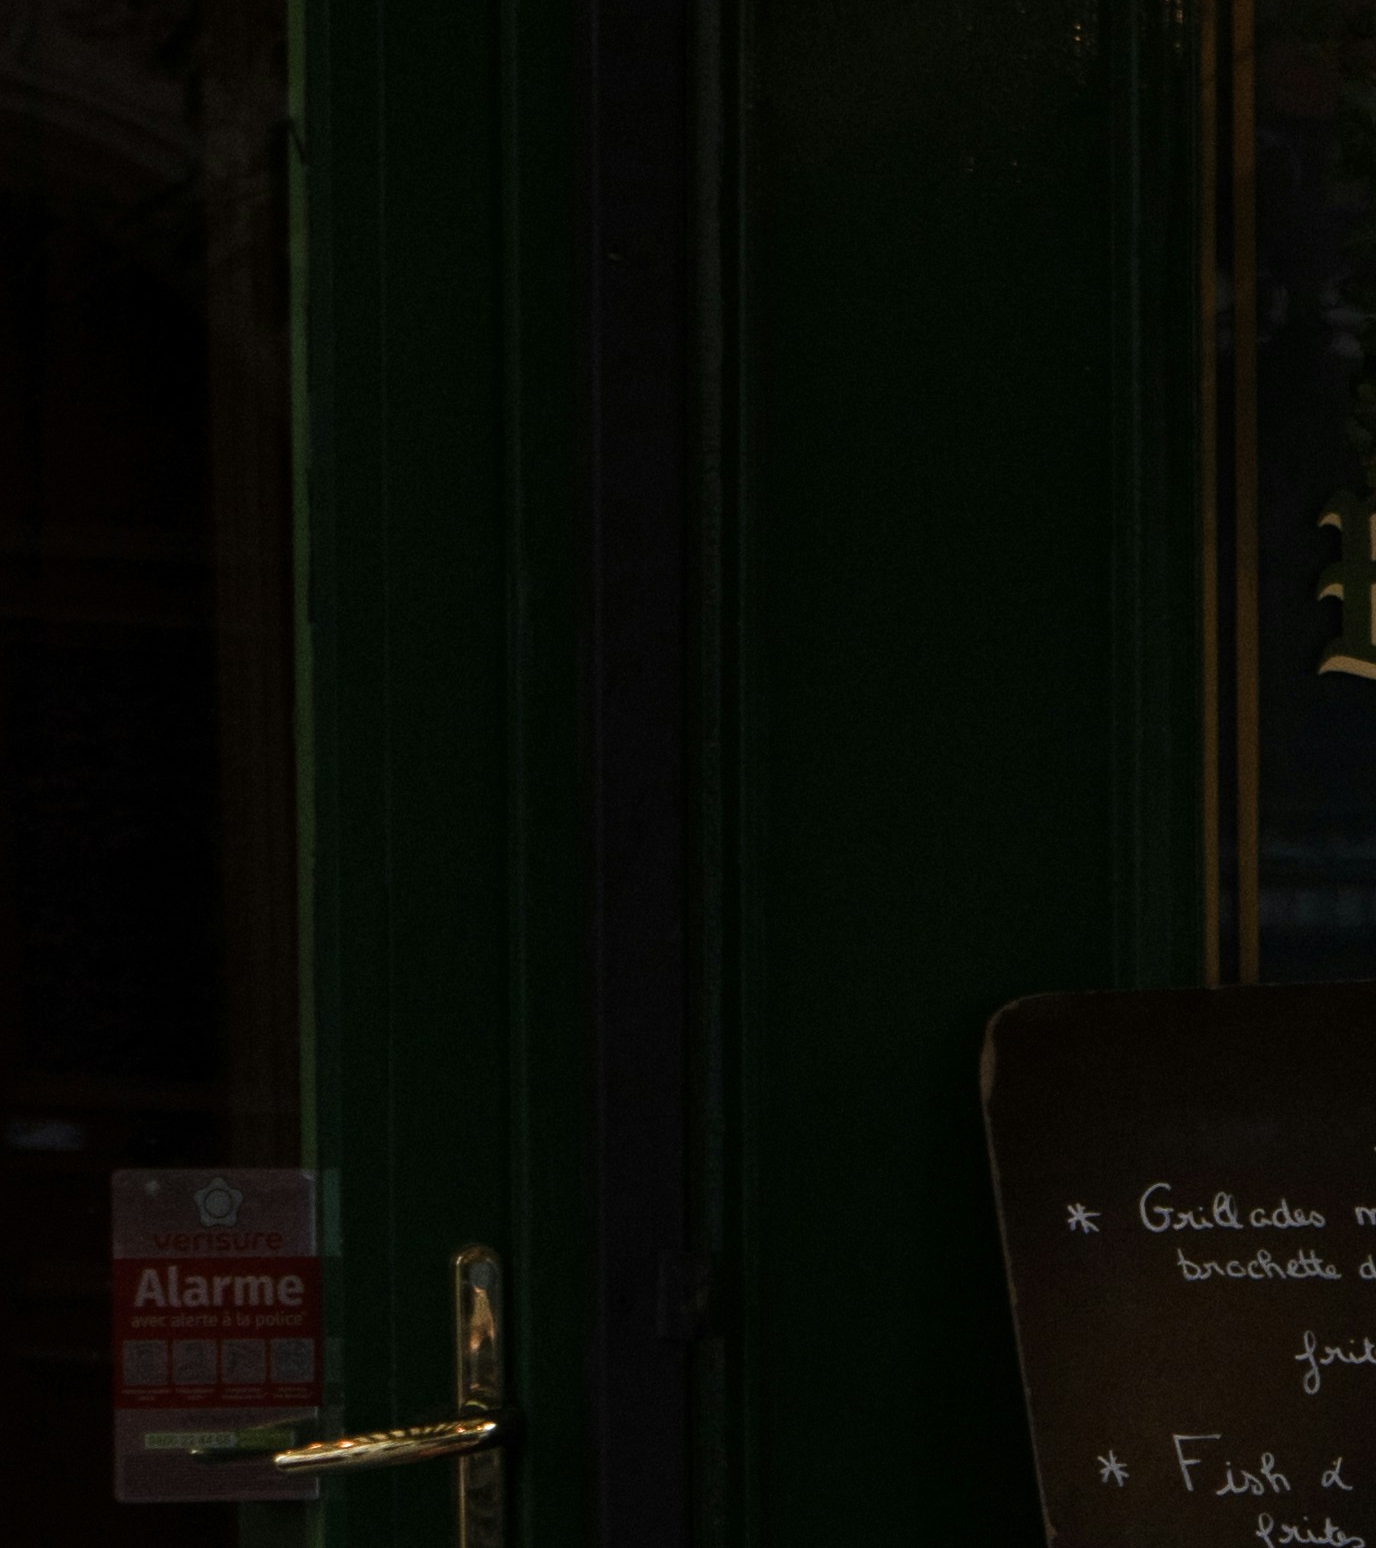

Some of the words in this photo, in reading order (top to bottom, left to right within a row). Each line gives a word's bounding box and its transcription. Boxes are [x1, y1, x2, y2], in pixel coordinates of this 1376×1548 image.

[1138, 1181, 1326, 1233] Grillades
[1176, 1248, 1342, 1281] brochette
[133, 1265, 305, 1308] Alarme
[131, 1316, 165, 1328] avec
[170, 1312, 218, 1328] alerte
[1172, 1433, 1291, 1496] Fish
